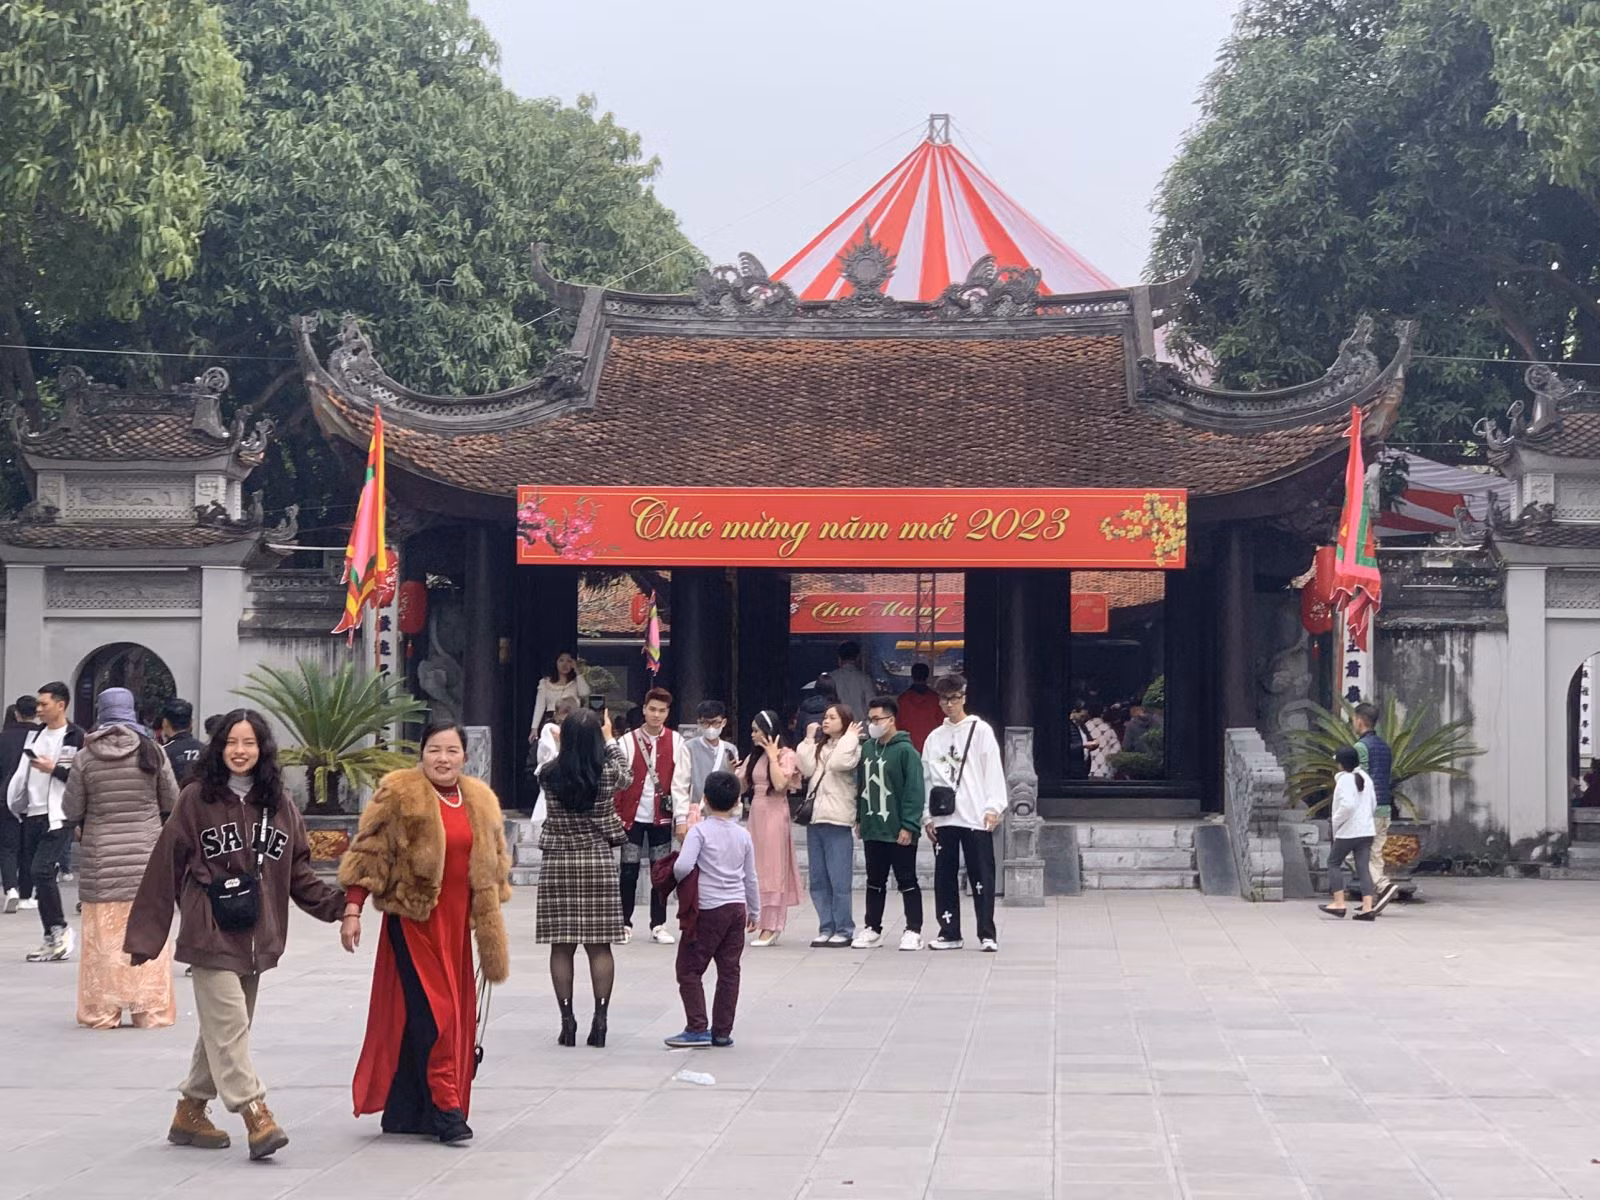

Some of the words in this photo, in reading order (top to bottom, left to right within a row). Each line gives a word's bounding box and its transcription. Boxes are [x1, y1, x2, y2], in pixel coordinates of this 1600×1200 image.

[631, 496, 714, 540] Chúc
[720, 511, 812, 557] mừng
[818, 512, 890, 540] năm
[898, 512, 958, 541] mới
[965, 507, 1070, 541] 2023
